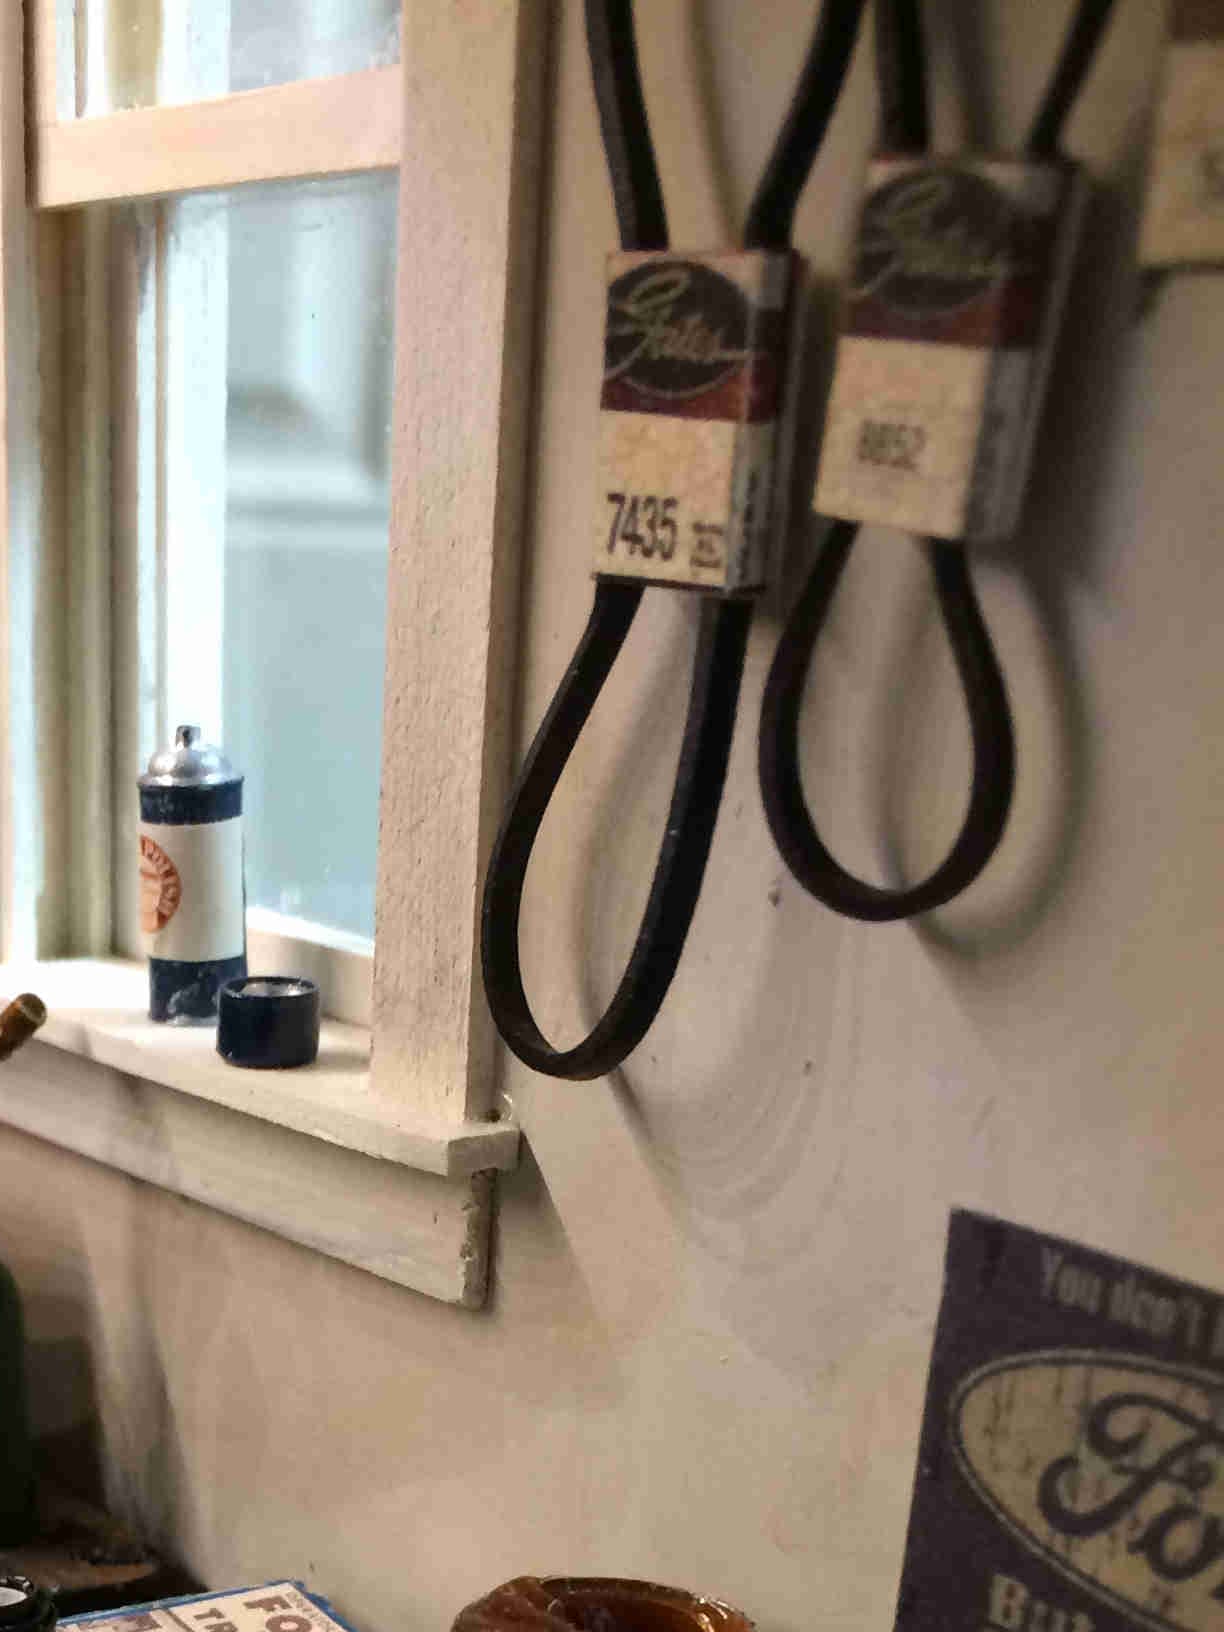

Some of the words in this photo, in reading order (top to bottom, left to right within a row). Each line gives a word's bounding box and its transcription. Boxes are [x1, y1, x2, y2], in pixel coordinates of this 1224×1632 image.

[606, 493, 678, 560] 7435
[1040, 1247, 1102, 1317] You
[1037, 1392, 1224, 1602] Fo
